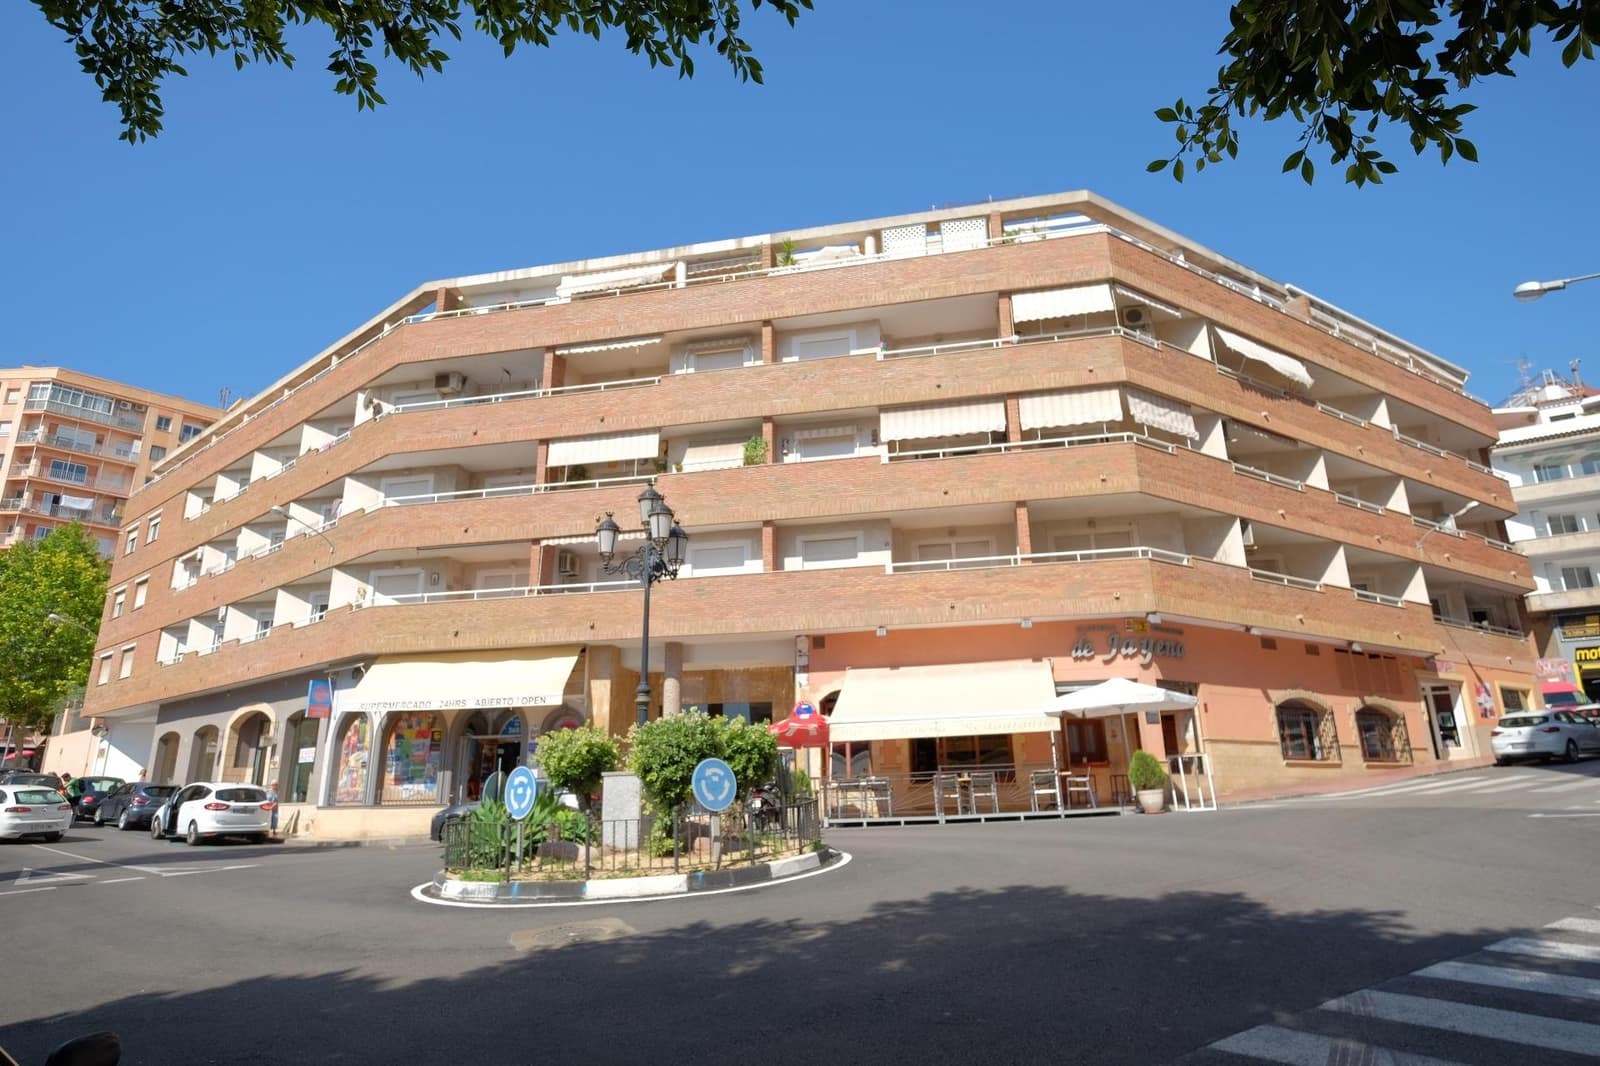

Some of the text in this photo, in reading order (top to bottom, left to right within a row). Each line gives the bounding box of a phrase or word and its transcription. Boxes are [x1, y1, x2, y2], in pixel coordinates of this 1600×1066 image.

[1576, 647, 1600, 661] mo
[475, 697, 514, 706] ABIERTO
[521, 696, 547, 705] OPEN
